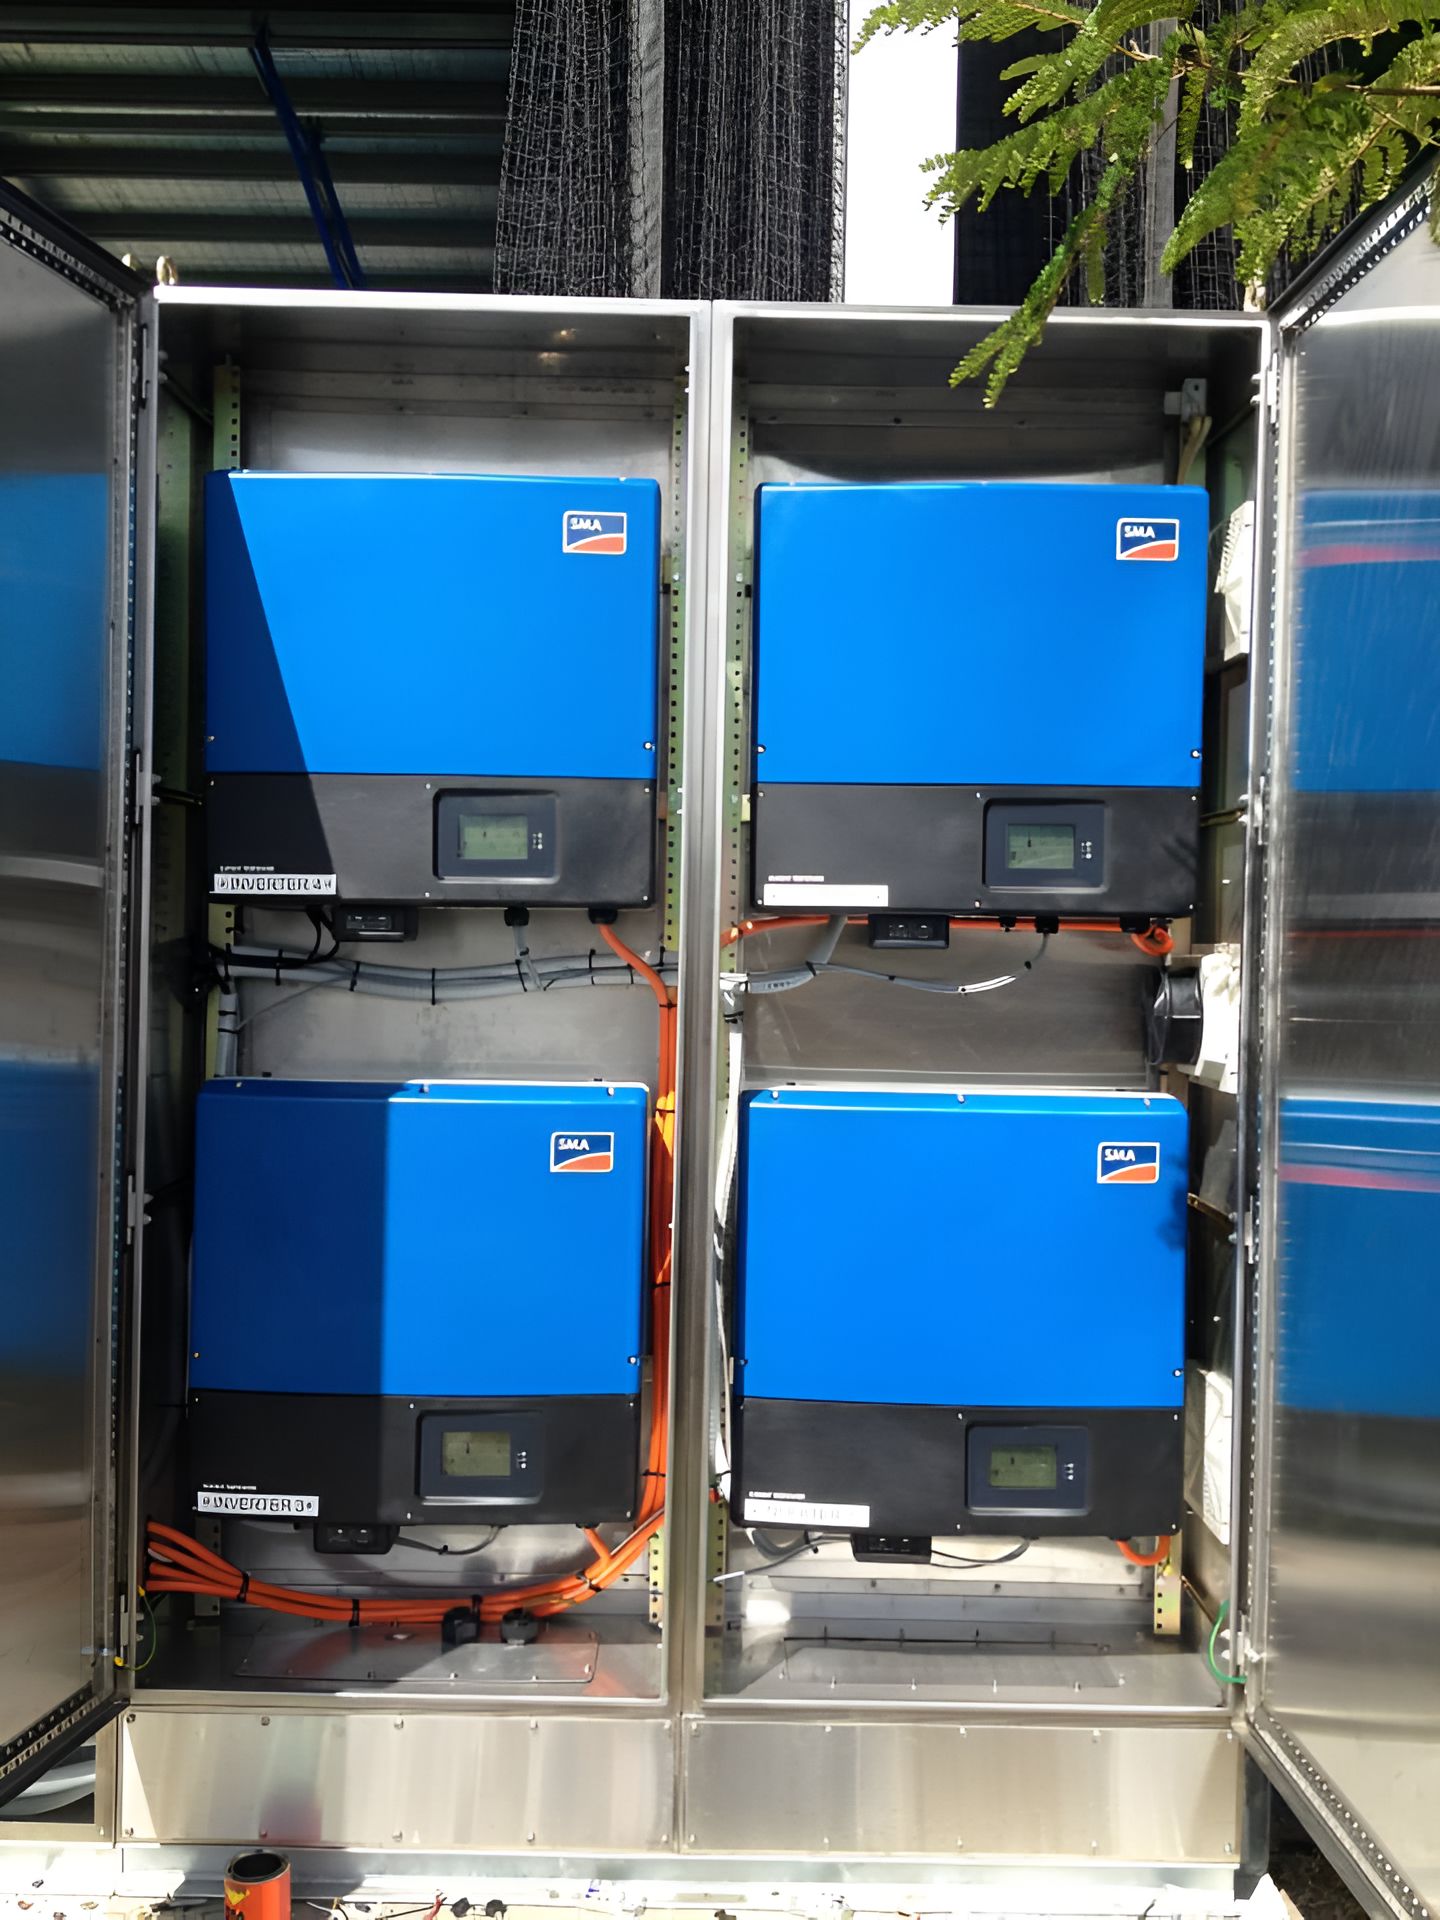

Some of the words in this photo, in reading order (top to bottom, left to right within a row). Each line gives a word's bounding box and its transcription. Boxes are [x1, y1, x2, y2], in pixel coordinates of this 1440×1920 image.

[570, 517, 601, 531] SMA
[1124, 525, 1155, 538] SMA
[558, 1138, 589, 1151] SMA
[1104, 1148, 1135, 1162] SMA
